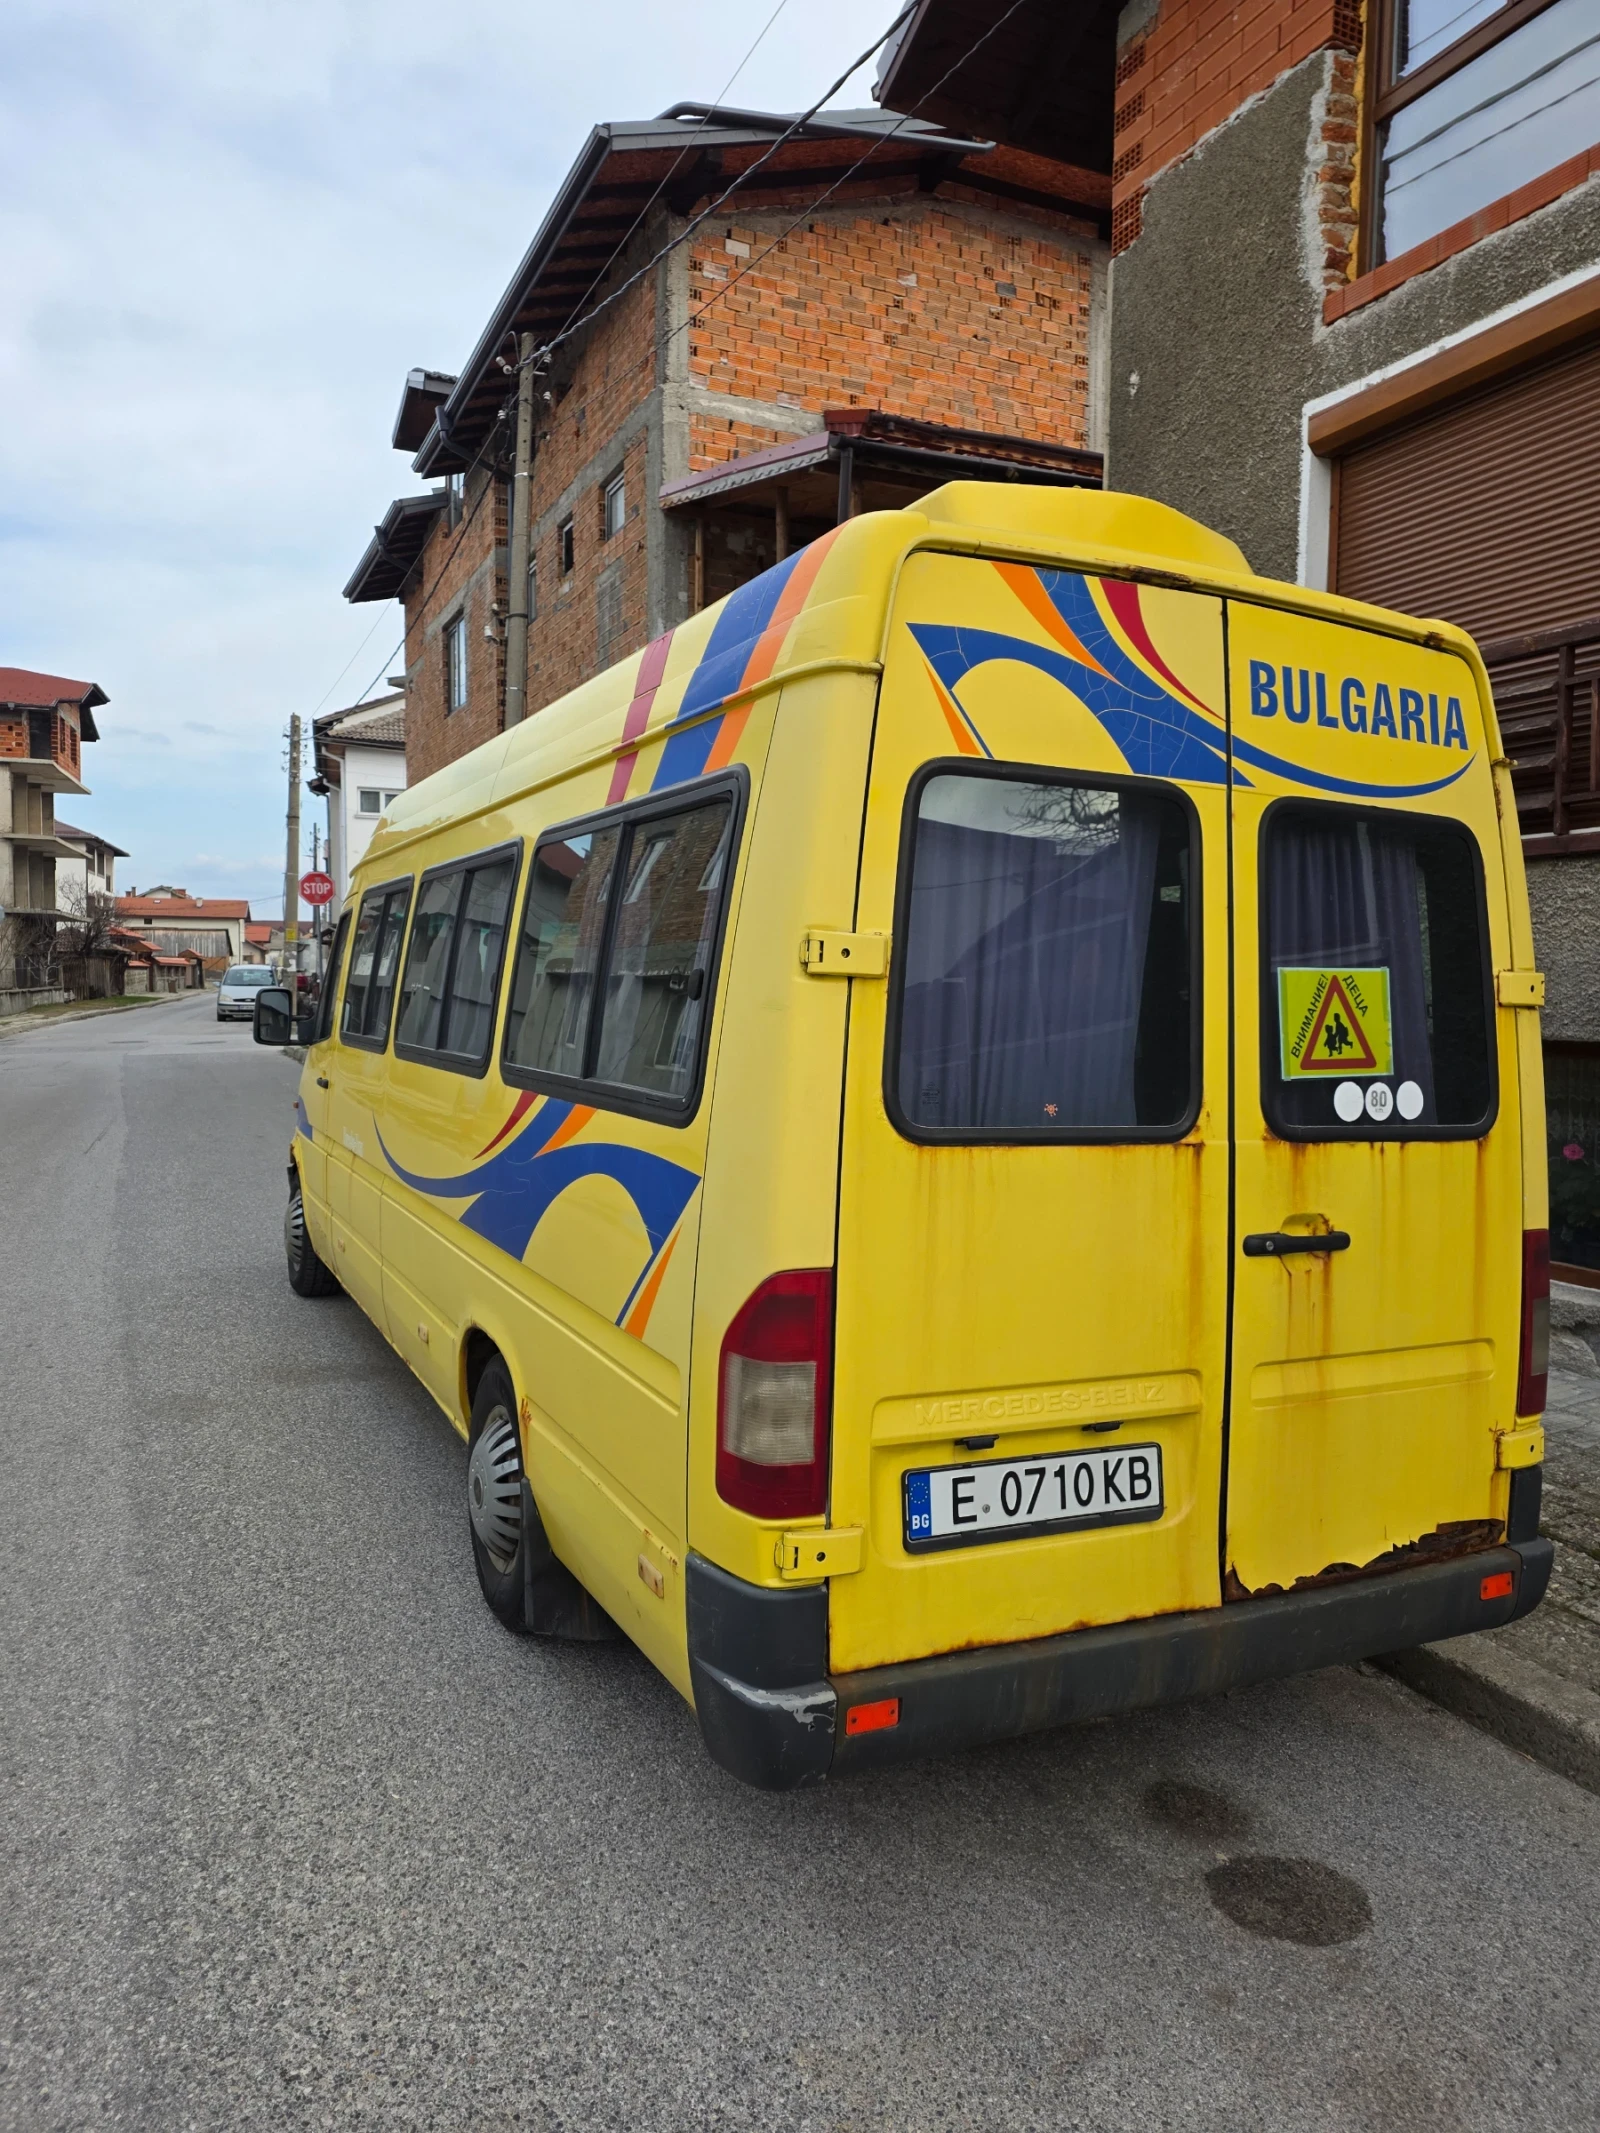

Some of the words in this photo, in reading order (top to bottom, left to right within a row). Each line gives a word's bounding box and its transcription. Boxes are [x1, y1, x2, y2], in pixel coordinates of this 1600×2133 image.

[1249, 659, 1469, 751] BULGARIA
[303, 882, 331, 894] STOP
[1290, 973, 1329, 1059] ВНИМАНИЕ!
[1342, 974, 1369, 1018] ДЕЦА
[1371, 1090, 1388, 1108] 80
[915, 1382, 1165, 1427] MERCEDES-BENZ
[911, 1513, 930, 1530] BG
